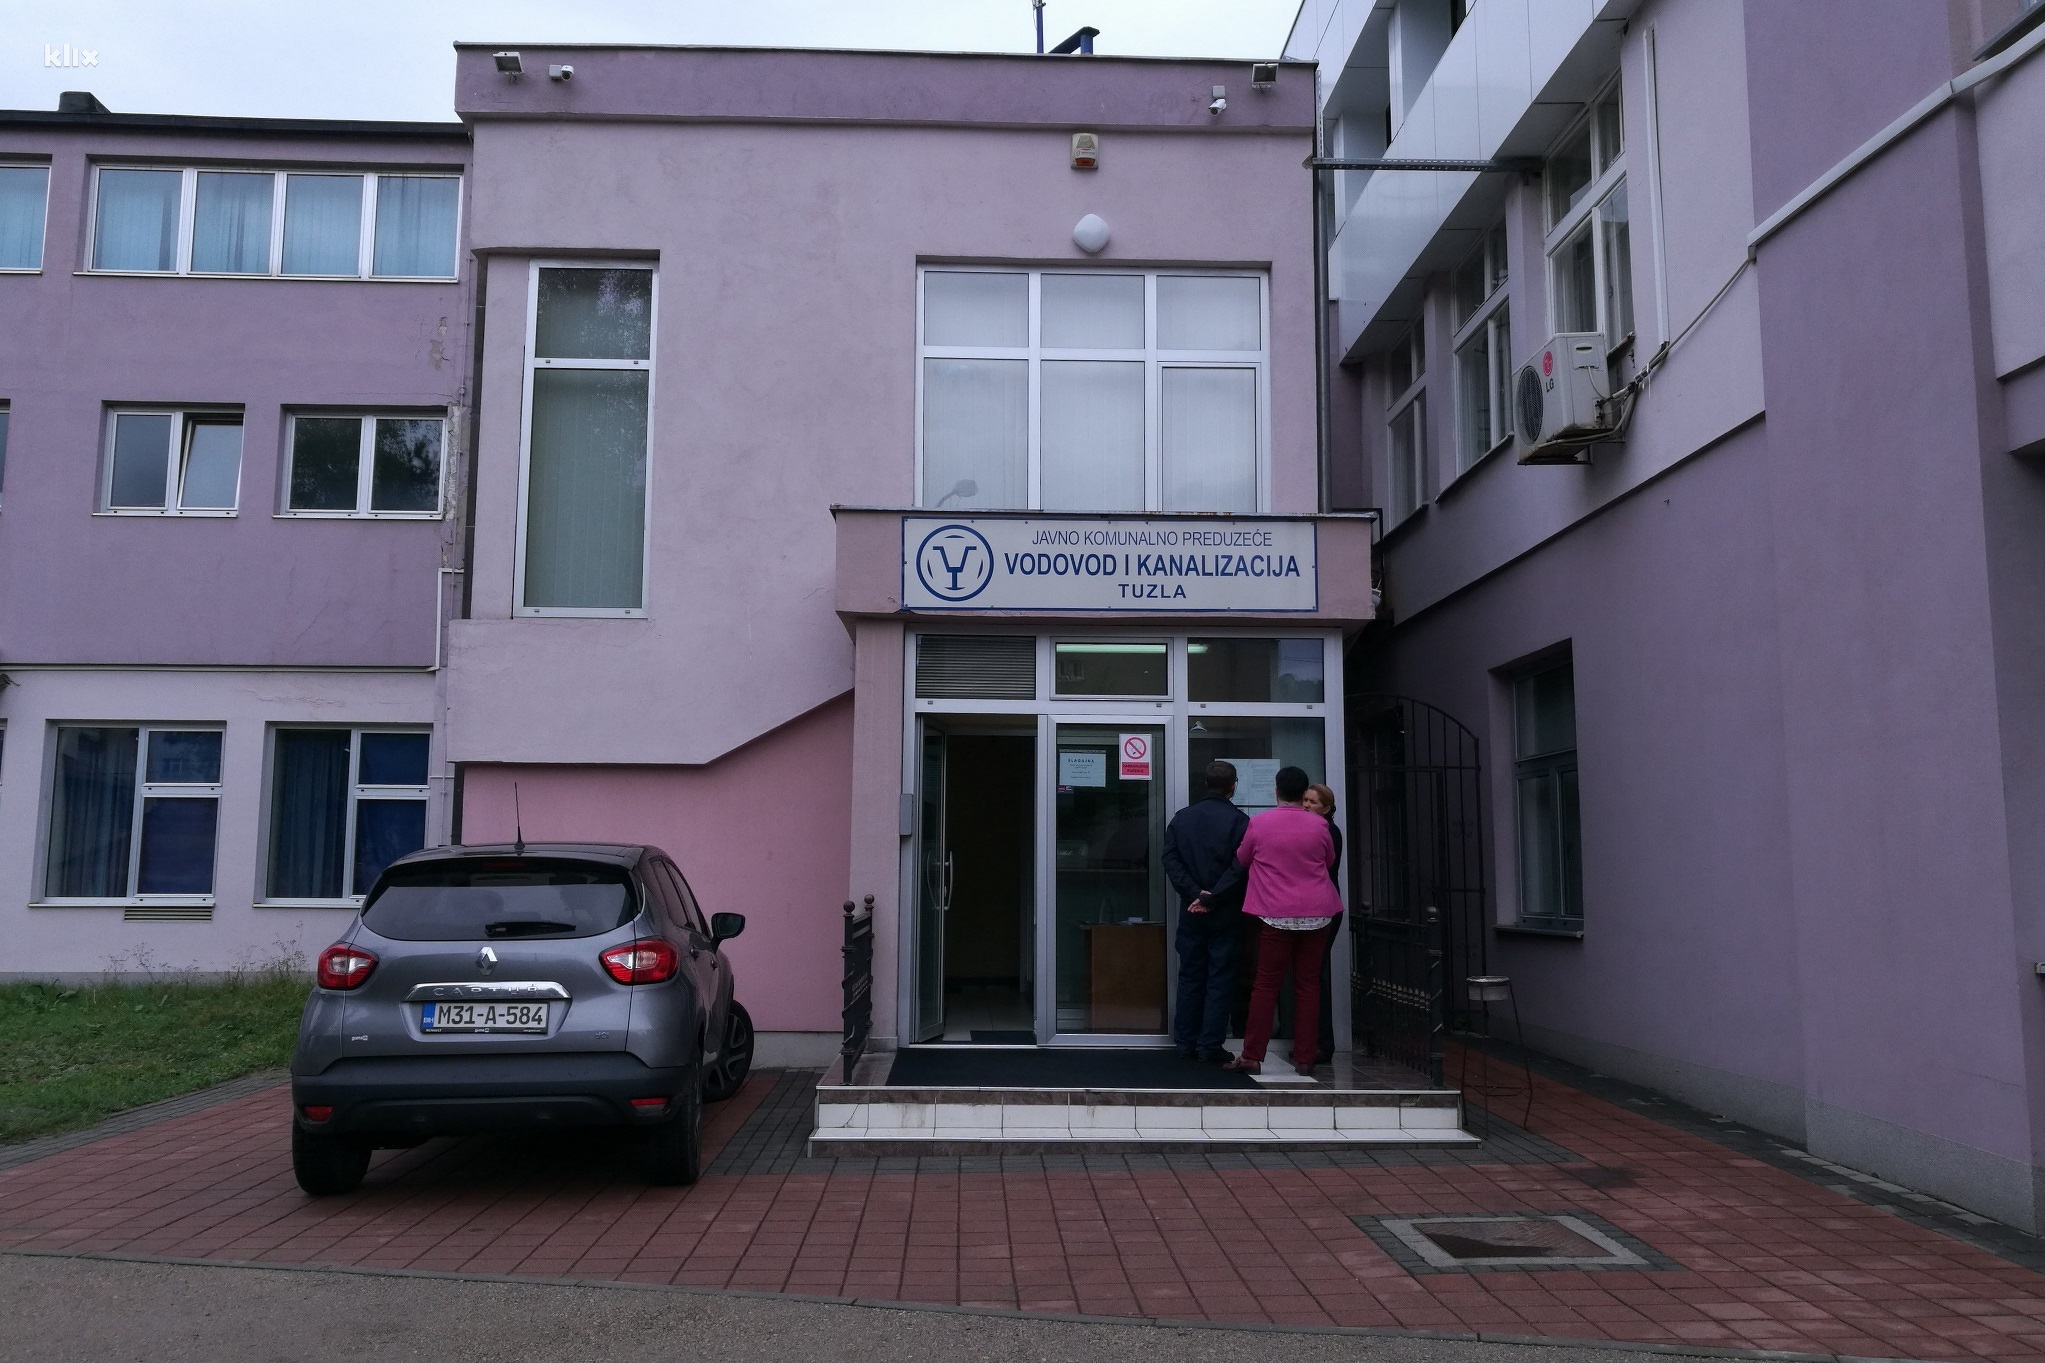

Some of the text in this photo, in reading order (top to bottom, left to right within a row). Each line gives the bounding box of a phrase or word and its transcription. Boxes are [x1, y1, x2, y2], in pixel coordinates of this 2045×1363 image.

[1546, 378, 1554, 392] LG
[1032, 529, 1273, 547] JAVNO KOMUNALNO PREDUZEĆE
[1004, 552, 1301, 578] VODOVOD I KANALIZACIJA
[1118, 583, 1187, 599] TUZLA
[437, 1005, 543, 1025] M31-A-584
